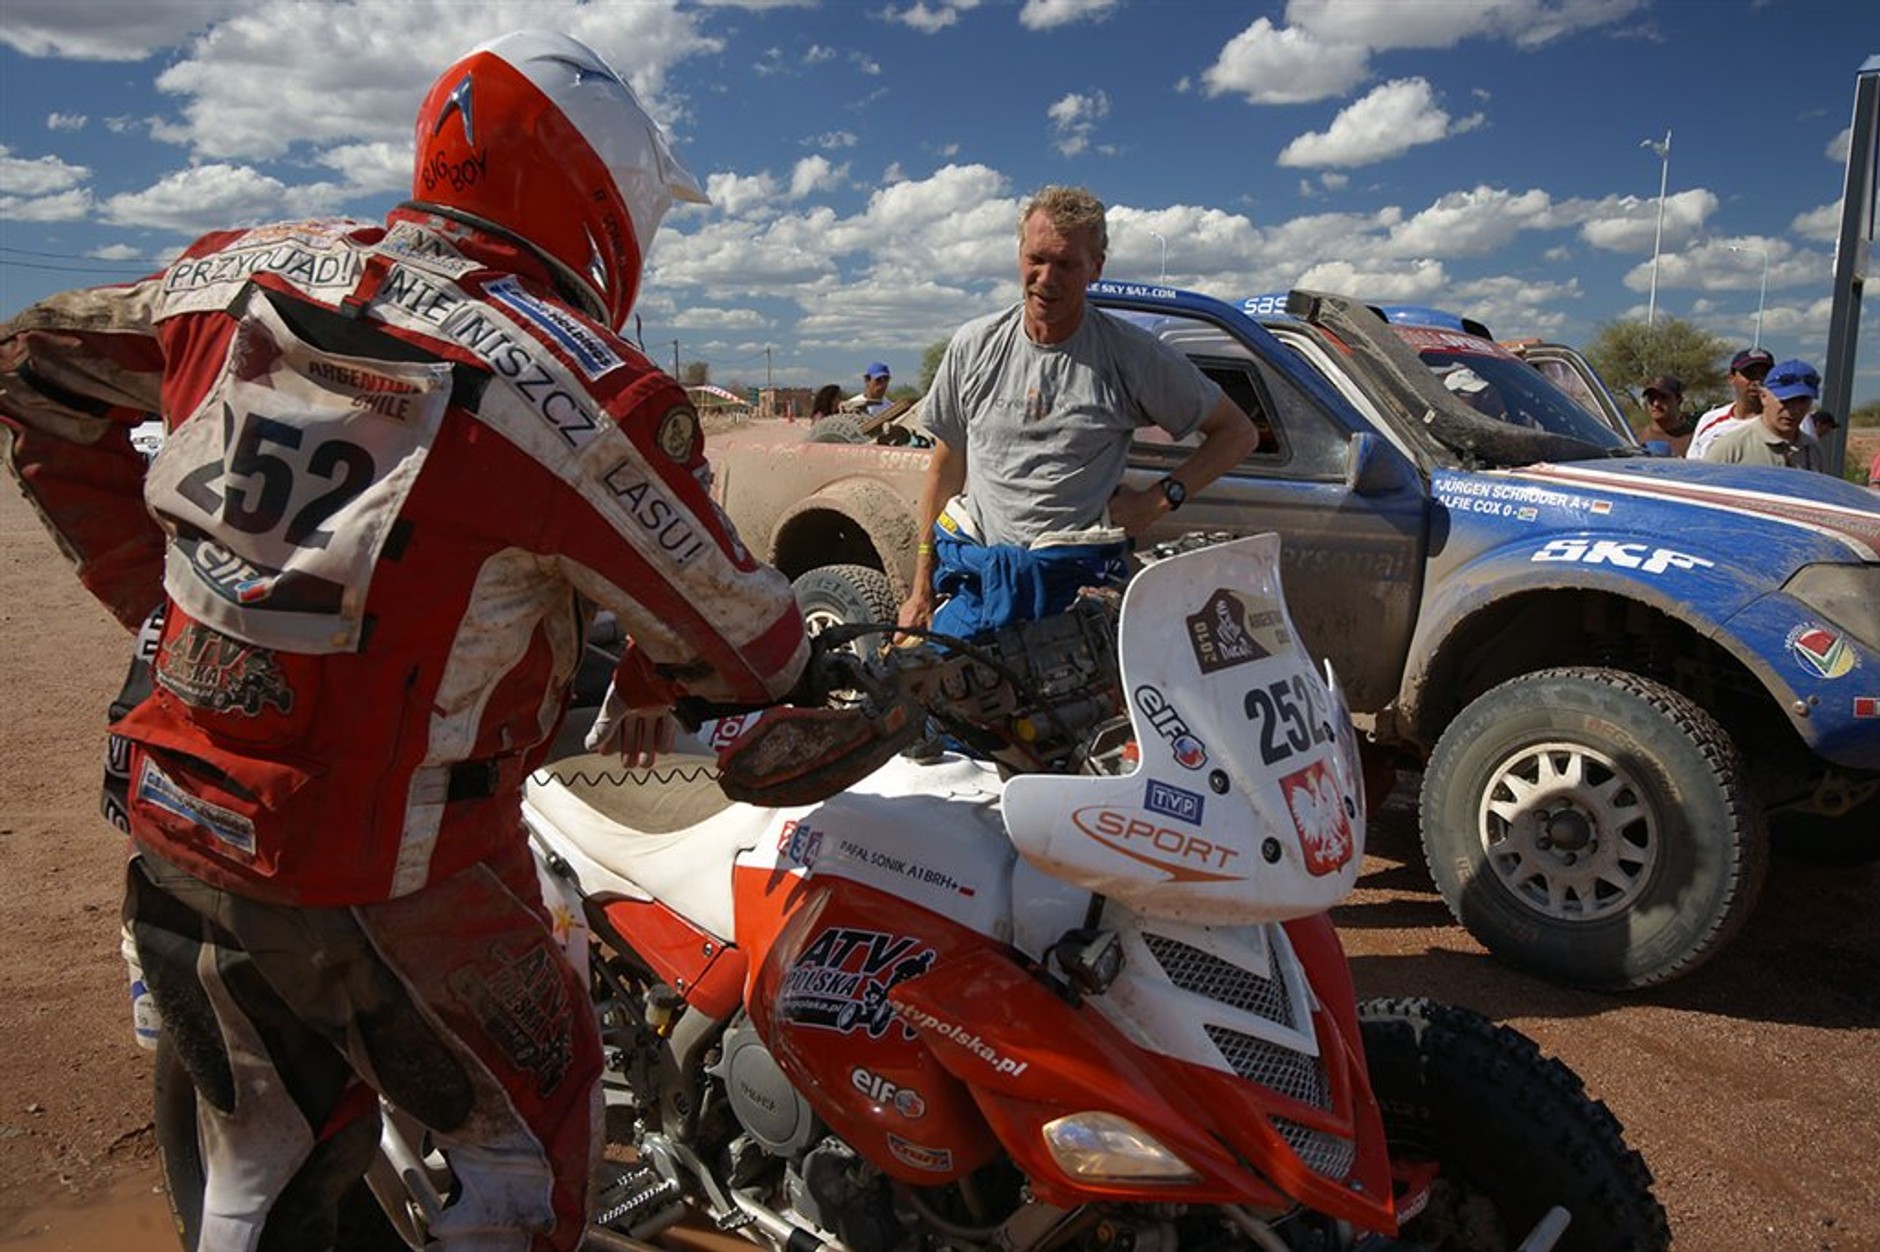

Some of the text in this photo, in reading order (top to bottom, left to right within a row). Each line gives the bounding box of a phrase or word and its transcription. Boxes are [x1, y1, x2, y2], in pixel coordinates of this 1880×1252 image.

[421, 151, 448, 192] BIG
[450, 148, 487, 193] BOY
[1101, 283, 1123, 294] SKY
[382, 266, 453, 321] NIE
[456, 314, 597, 448] NISZCZ
[603, 461, 703, 563] LASU!
[175, 400, 375, 550] 252
[1439, 475, 1489, 497] JÜRGEN
[1473, 500, 1500, 515] COX
[1531, 539, 1715, 574] SKF
[1134, 685, 1191, 743] elf
[1244, 674, 1327, 766] 252
[1154, 789, 1196, 814] TVP
[1096, 811, 1239, 869] SPORT
[871, 851, 908, 875] SONIK
[793, 927, 921, 975] ATV
[785, 968, 861, 998] POLSKA
[890, 999, 1029, 1077] atvpolska.pl
[851, 1067, 898, 1103] elf
